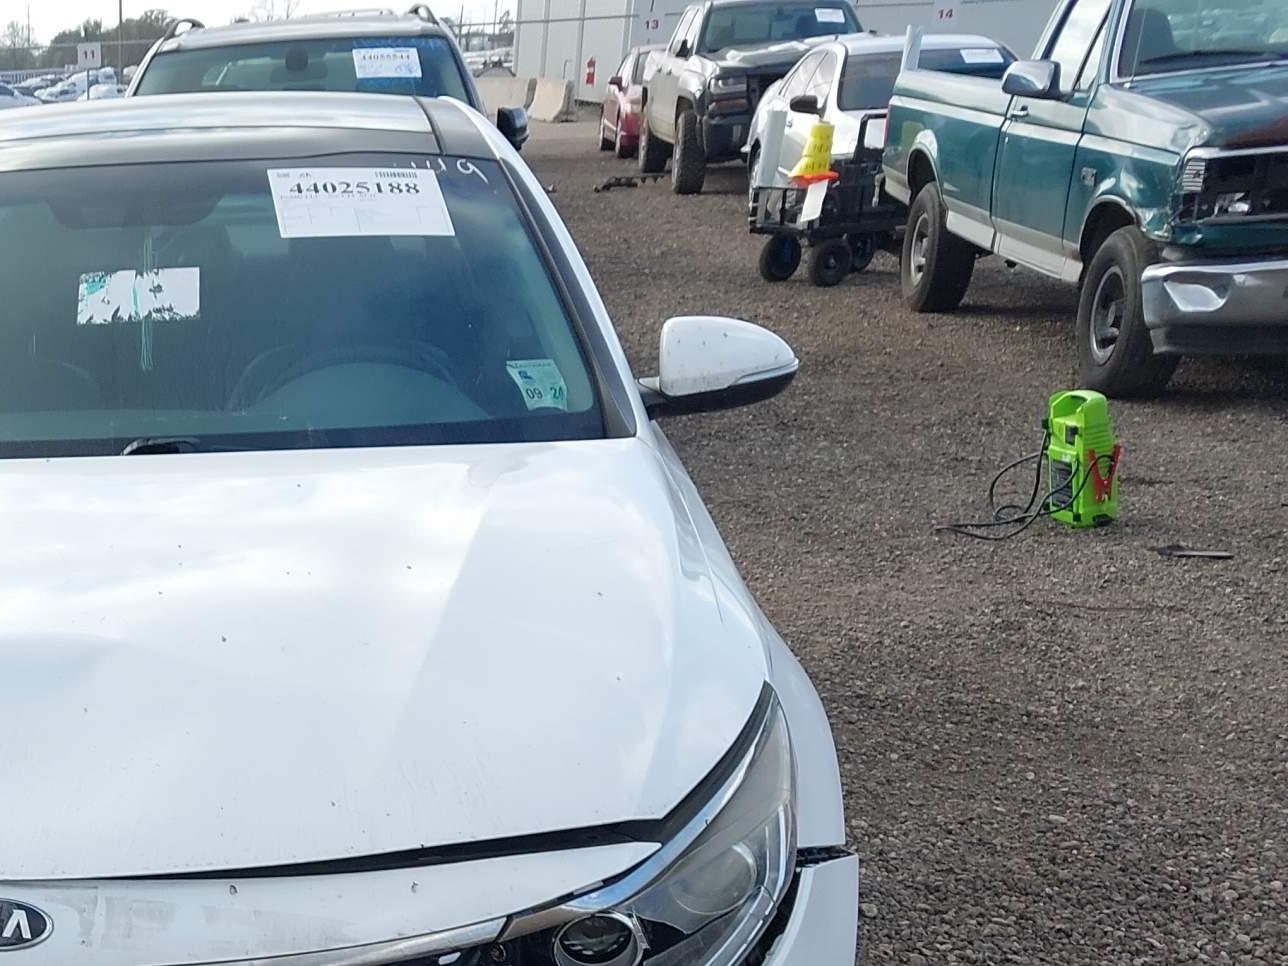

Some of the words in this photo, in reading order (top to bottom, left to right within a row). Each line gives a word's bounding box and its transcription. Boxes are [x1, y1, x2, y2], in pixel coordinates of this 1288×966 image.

[938, 9, 953, 19] 14
[645, 19, 659, 30] 13
[84, 50, 95, 60] 11
[289, 181, 420, 195] 44025188
[526, 387, 544, 400] 09
